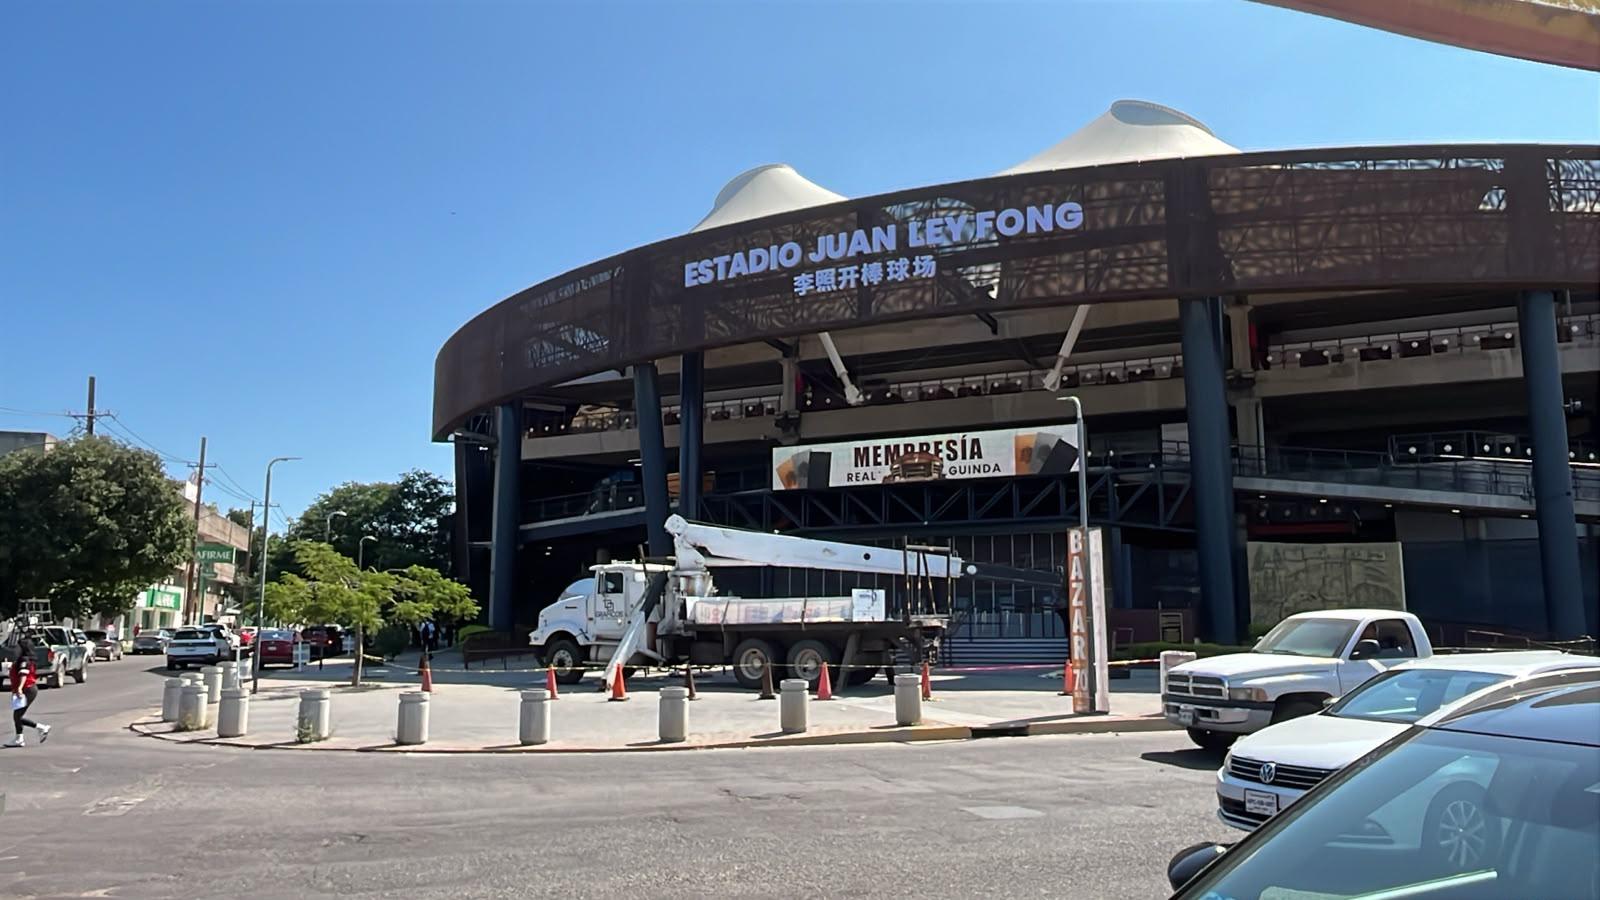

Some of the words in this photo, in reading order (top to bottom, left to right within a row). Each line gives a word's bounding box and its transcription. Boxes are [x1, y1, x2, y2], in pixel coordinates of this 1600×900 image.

[684, 241, 803, 288] ESTADIO
[808, 225, 897, 263] JUAN
[908, 215, 968, 248] LEY
[975, 201, 1084, 239] FONG
[793, 254, 937, 297] 李照开棒球场
[846, 471, 877, 483] REAL
[948, 463, 1002, 476] GUINDA
[196, 550, 232, 561] AFIRME
[1070, 530, 1086, 660] BAZAR
